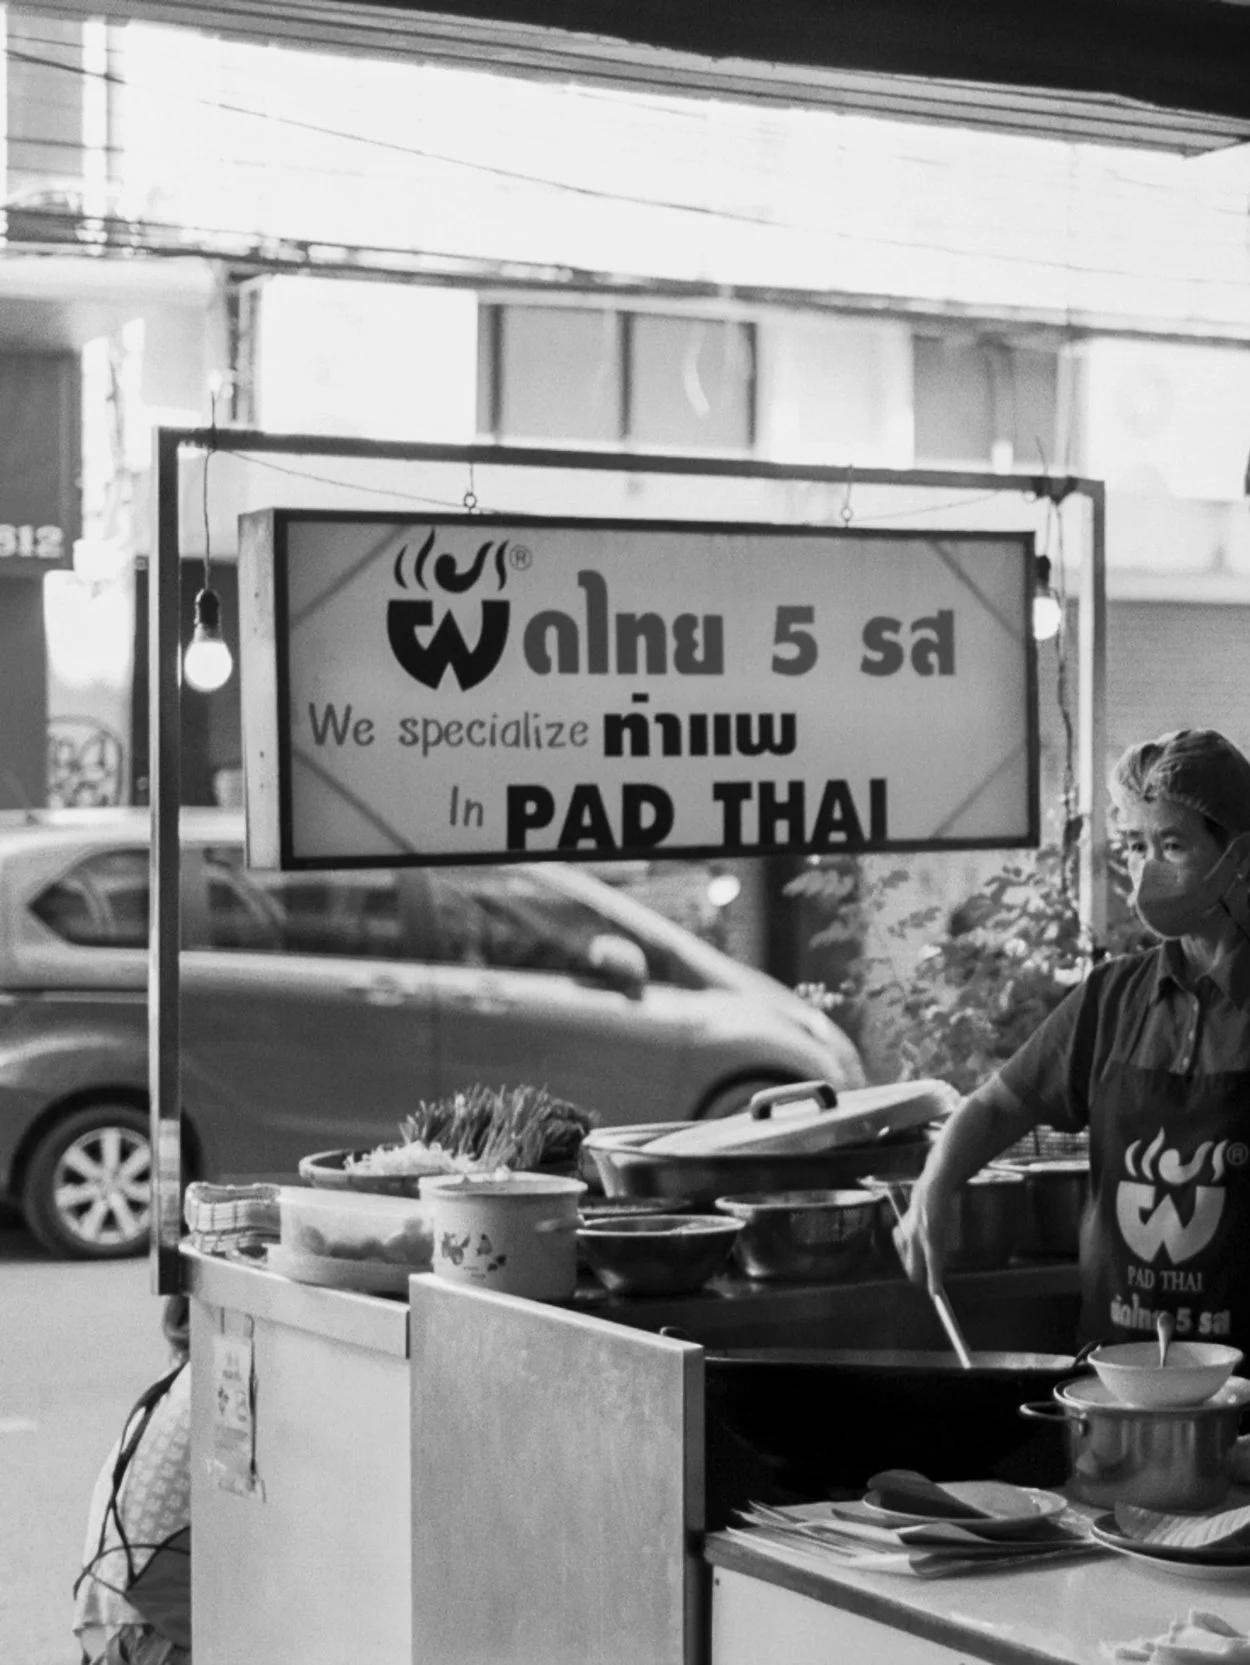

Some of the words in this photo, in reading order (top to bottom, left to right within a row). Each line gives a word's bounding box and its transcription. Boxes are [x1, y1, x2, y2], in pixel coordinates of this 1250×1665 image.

[771, 605, 819, 676] 5
[860, 609, 957, 676] รส
[308, 701, 376, 749] We
[398, 710, 590, 758] specialize
[449, 786, 484, 828] In
[506, 784, 675, 849] PAD
[713, 778, 888, 847] THAI
[1127, 1265, 1155, 1290] PAD
[1159, 1269, 1204, 1292] THAI
[1175, 1307, 1193, 1333] 5
